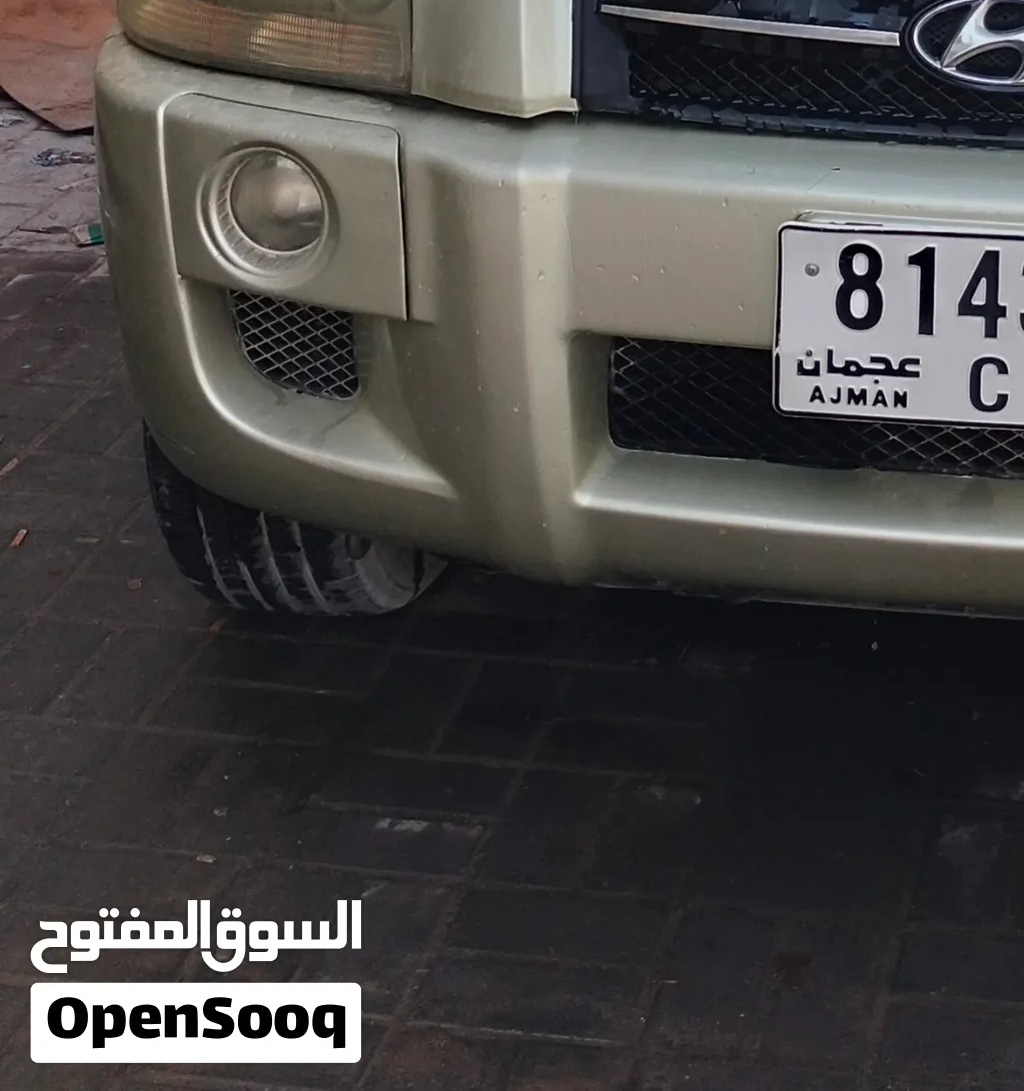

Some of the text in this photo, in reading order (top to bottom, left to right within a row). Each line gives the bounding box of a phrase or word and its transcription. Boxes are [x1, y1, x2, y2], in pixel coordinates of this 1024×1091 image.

[797, 347, 921, 384] عجمان
[809, 385, 908, 408] AJMAN
[968, 356, 1010, 413] C
